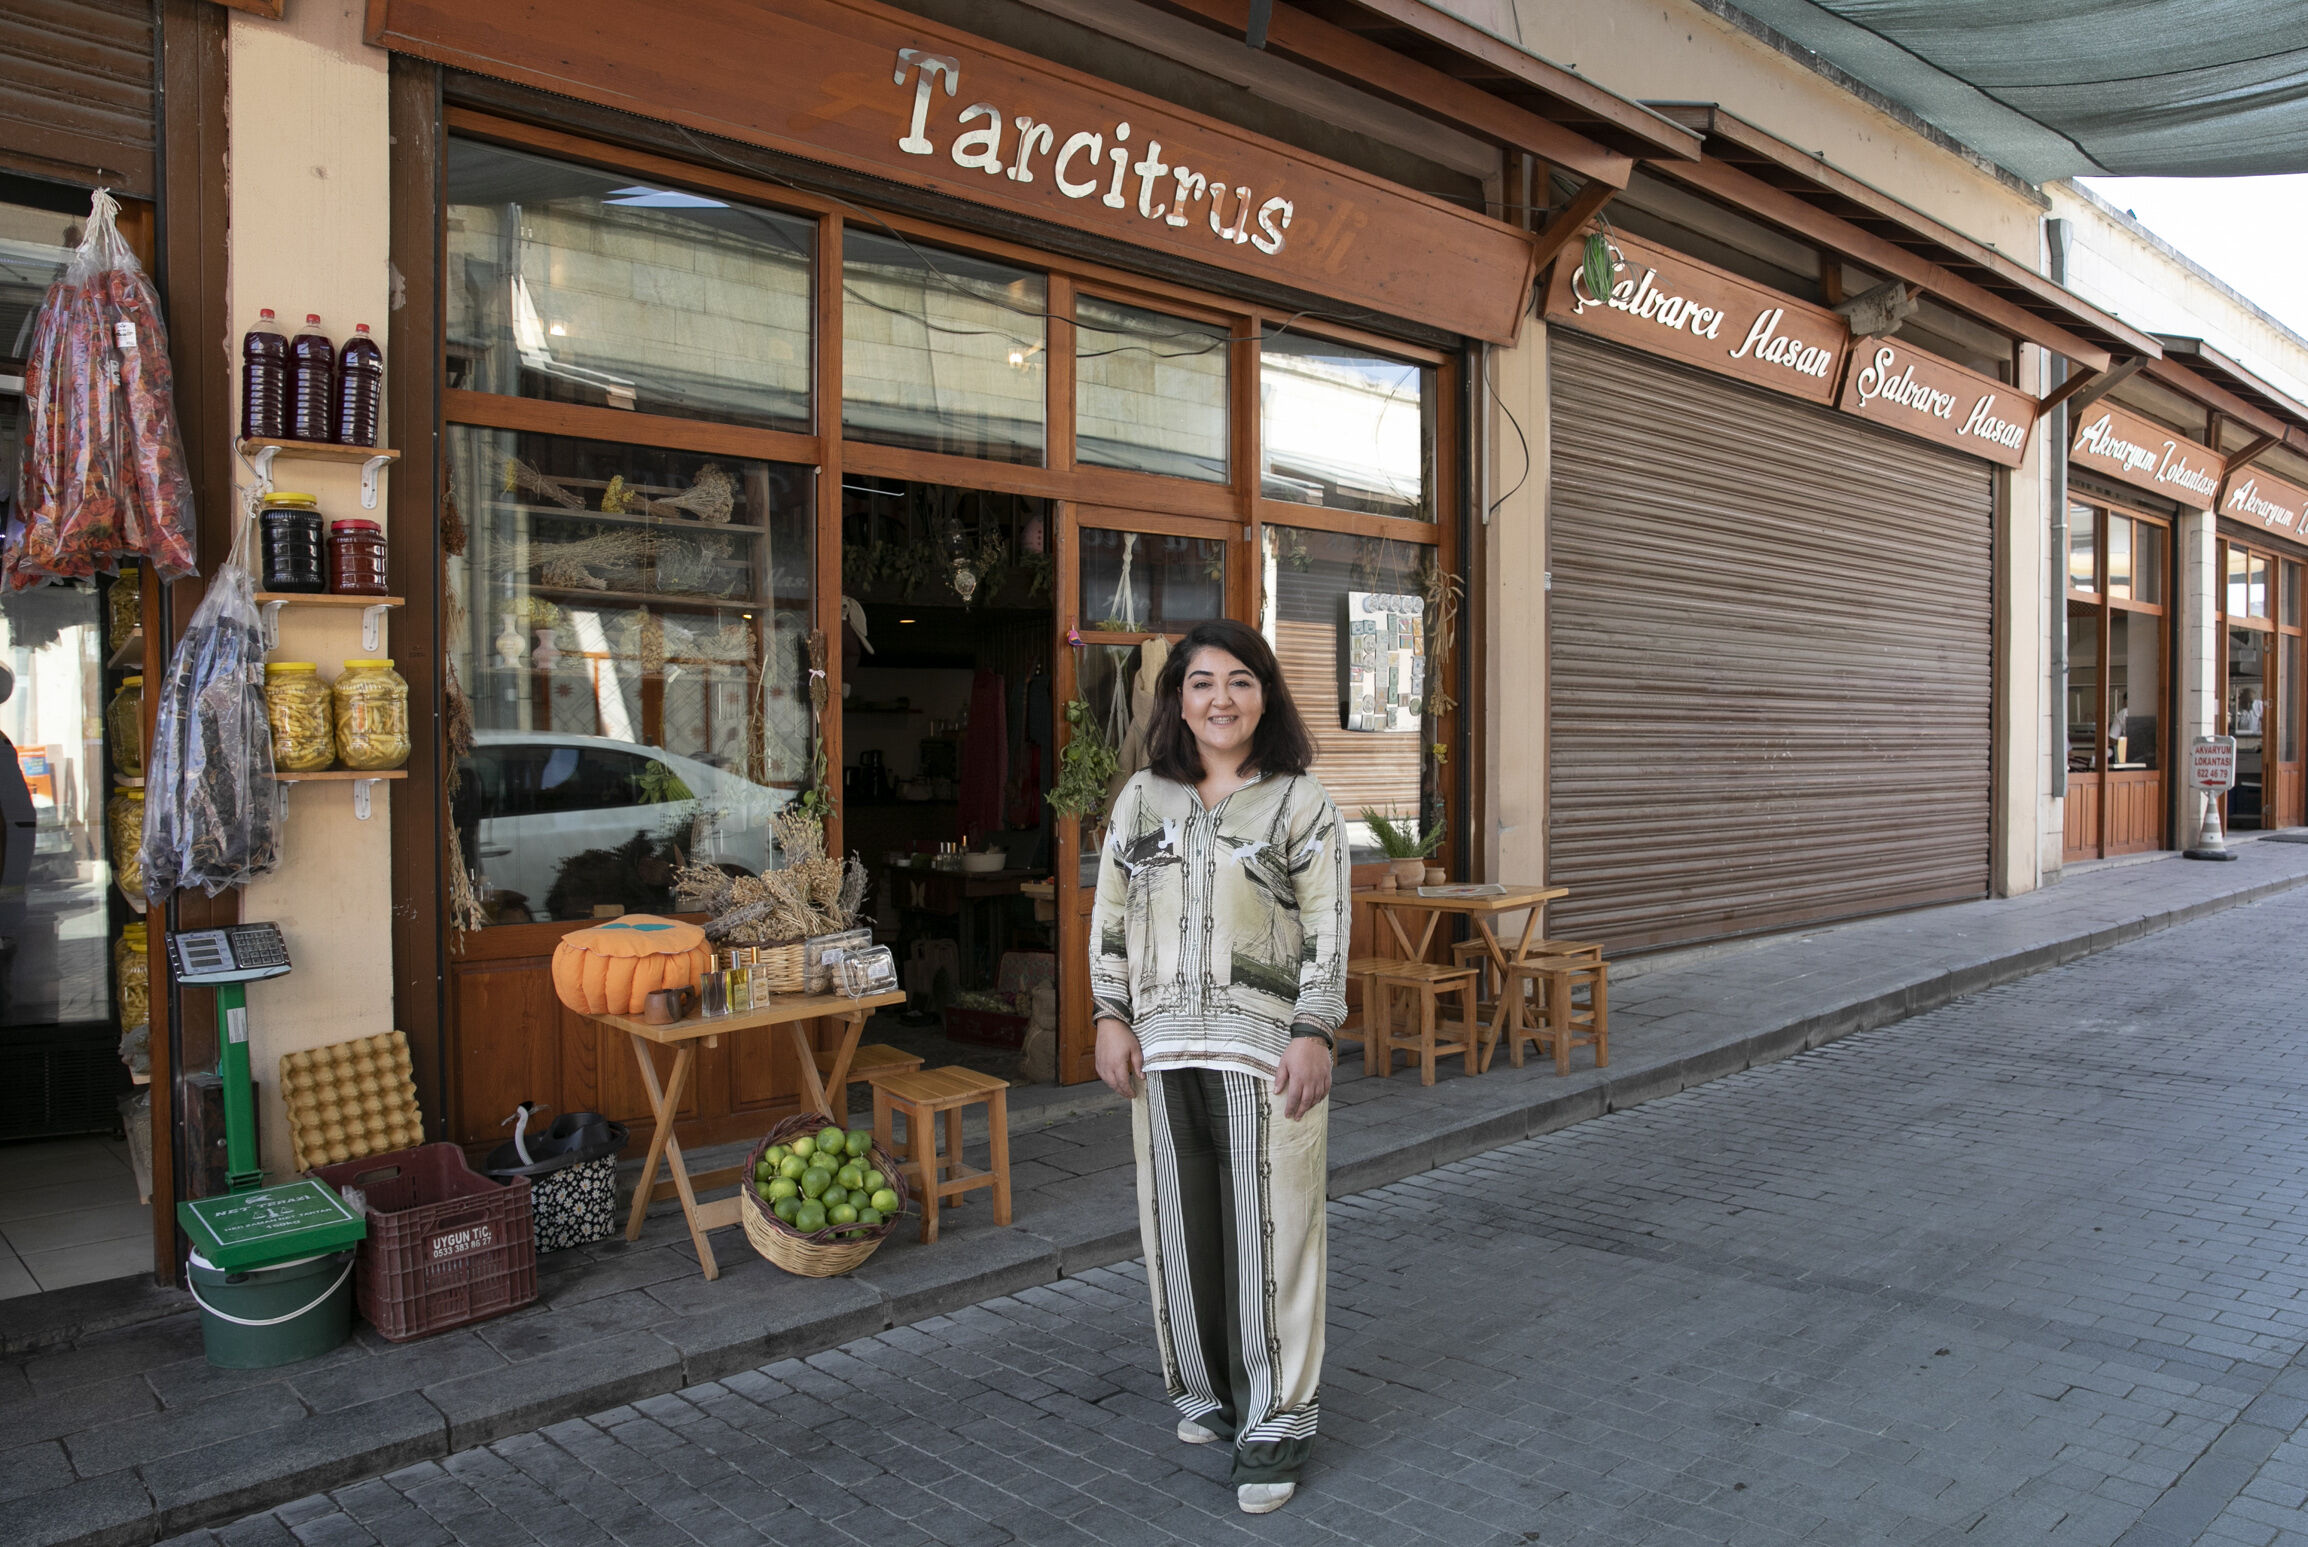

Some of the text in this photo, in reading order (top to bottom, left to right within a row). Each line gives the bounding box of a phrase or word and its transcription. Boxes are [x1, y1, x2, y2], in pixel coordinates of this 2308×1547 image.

[892, 47, 1295, 256] Tarcitrus
[1727, 307, 1834, 379] Hasan
[1856, 346, 2026, 451] Şalvarcı Hasan
[2073, 412, 2219, 498] Akvaryum Lokantası
[2226, 477, 2295, 528] Akvaryum
[2195, 746, 2232, 754] AKVARYUM
[2195, 757, 2232, 766] LOKANTASI
[215, 1206, 252, 1217] NET
[433, 1230, 470, 1249] UYGUN
[433, 1246, 453, 1258] 0533
[454, 1242, 470, 1253] 383
[482, 1237, 492, 1246] 27
